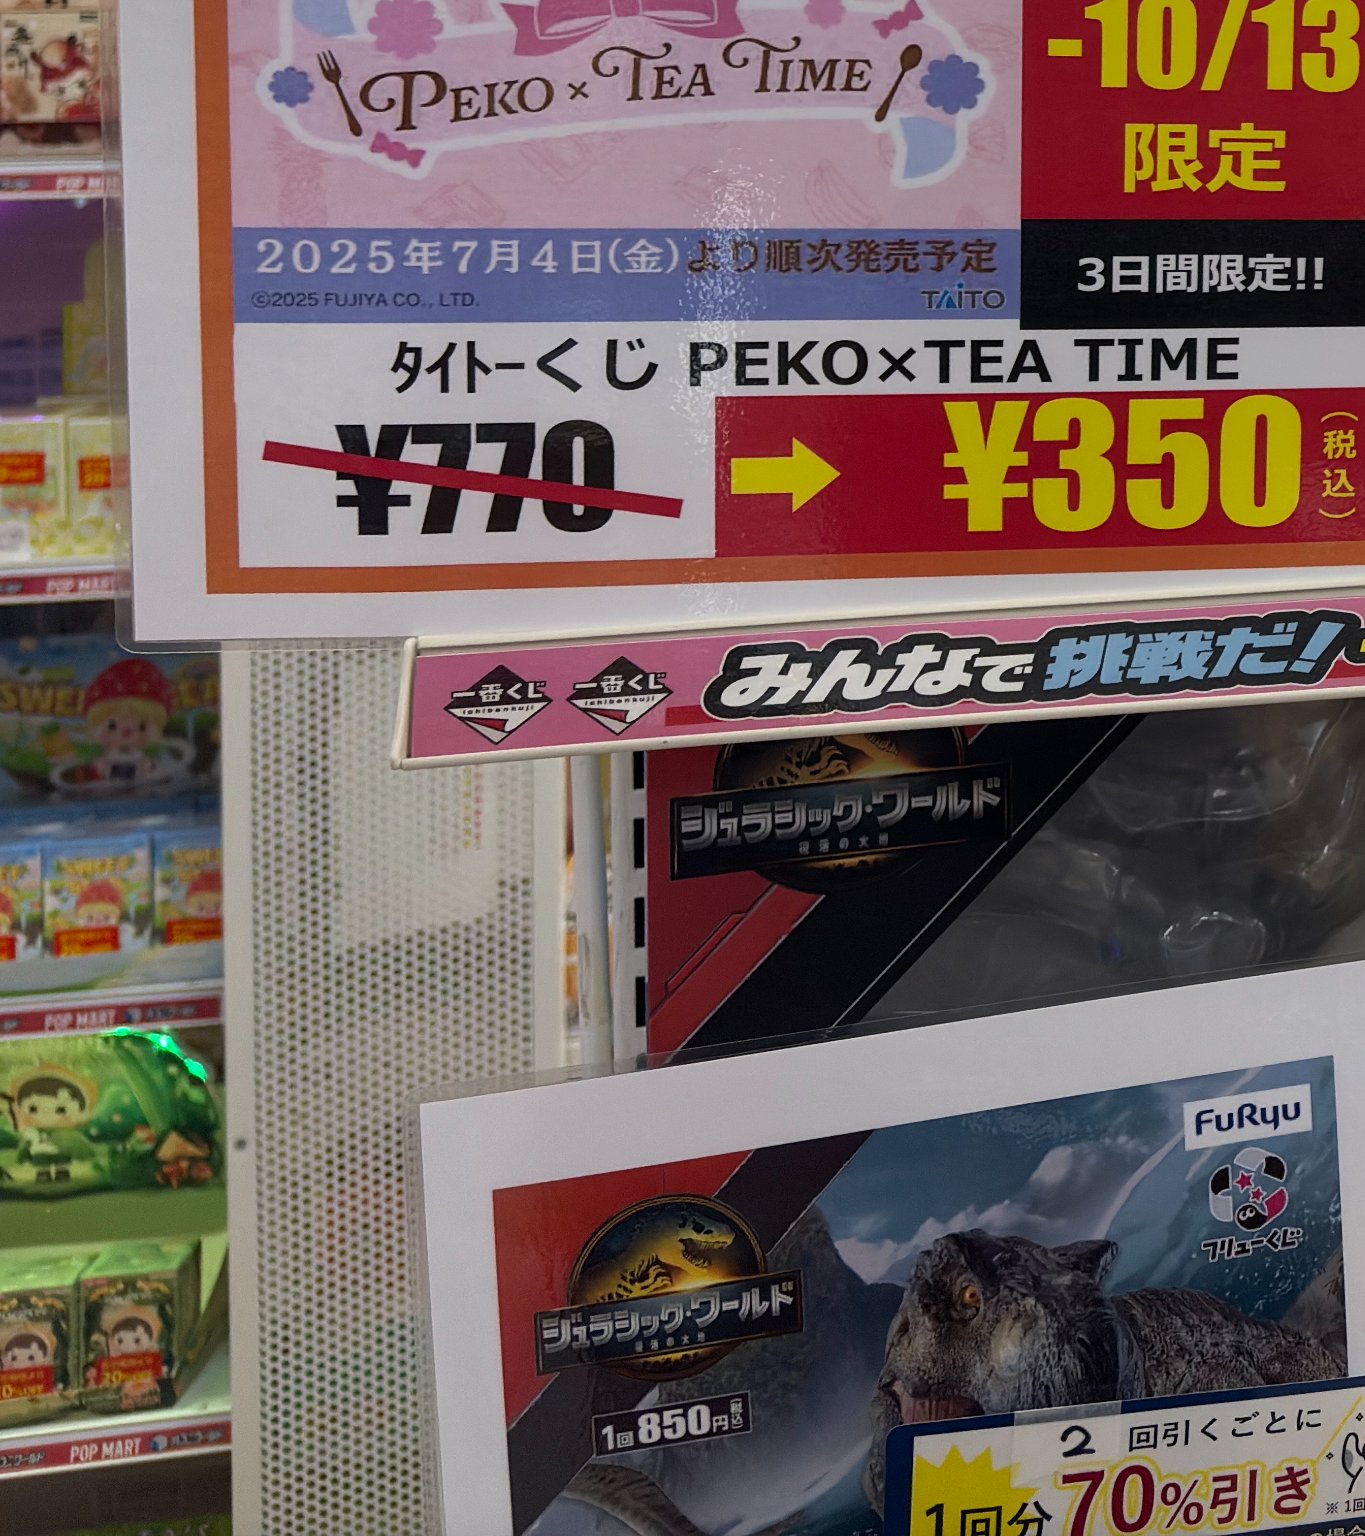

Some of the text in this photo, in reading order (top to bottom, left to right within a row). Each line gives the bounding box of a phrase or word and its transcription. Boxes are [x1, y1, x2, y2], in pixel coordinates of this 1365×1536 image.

[358, 69, 555, 132] PEKO
[591, 41, 716, 104] TEA
[722, 35, 874, 96] TIME
[1124, 122, 1289, 195] 限定
[1076, 255, 1326, 293] 3日間限定!!
[322, 292, 382, 308] FUJIYA
[430, 292, 480, 308] LTD.
[390, 334, 660, 396] タイトーくじ
[1074, 336, 1241, 383] TIME
[335, 418, 615, 538] ¥770
[942, 394, 1303, 534] ¥350
[451, 676, 549, 705] 一番くじ
[572, 669, 668, 698] 一番くじ
[680, 776, 1001, 853] ジュラシック・ワールド
[1195, 1101, 1301, 1136] FuRyu
[1202, 1228, 1302, 1262] フリューくじ
[541, 1279, 795, 1353] ジュラシック・ワールド
[69, 1444, 99, 1464] POP
[101, 1437, 142, 1459] MART
[1060, 1425, 1096, 1458] 2
[1128, 1407, 1323, 1453] 回引くごとに
[1061, 1464, 1314, 1536] 70%引き
